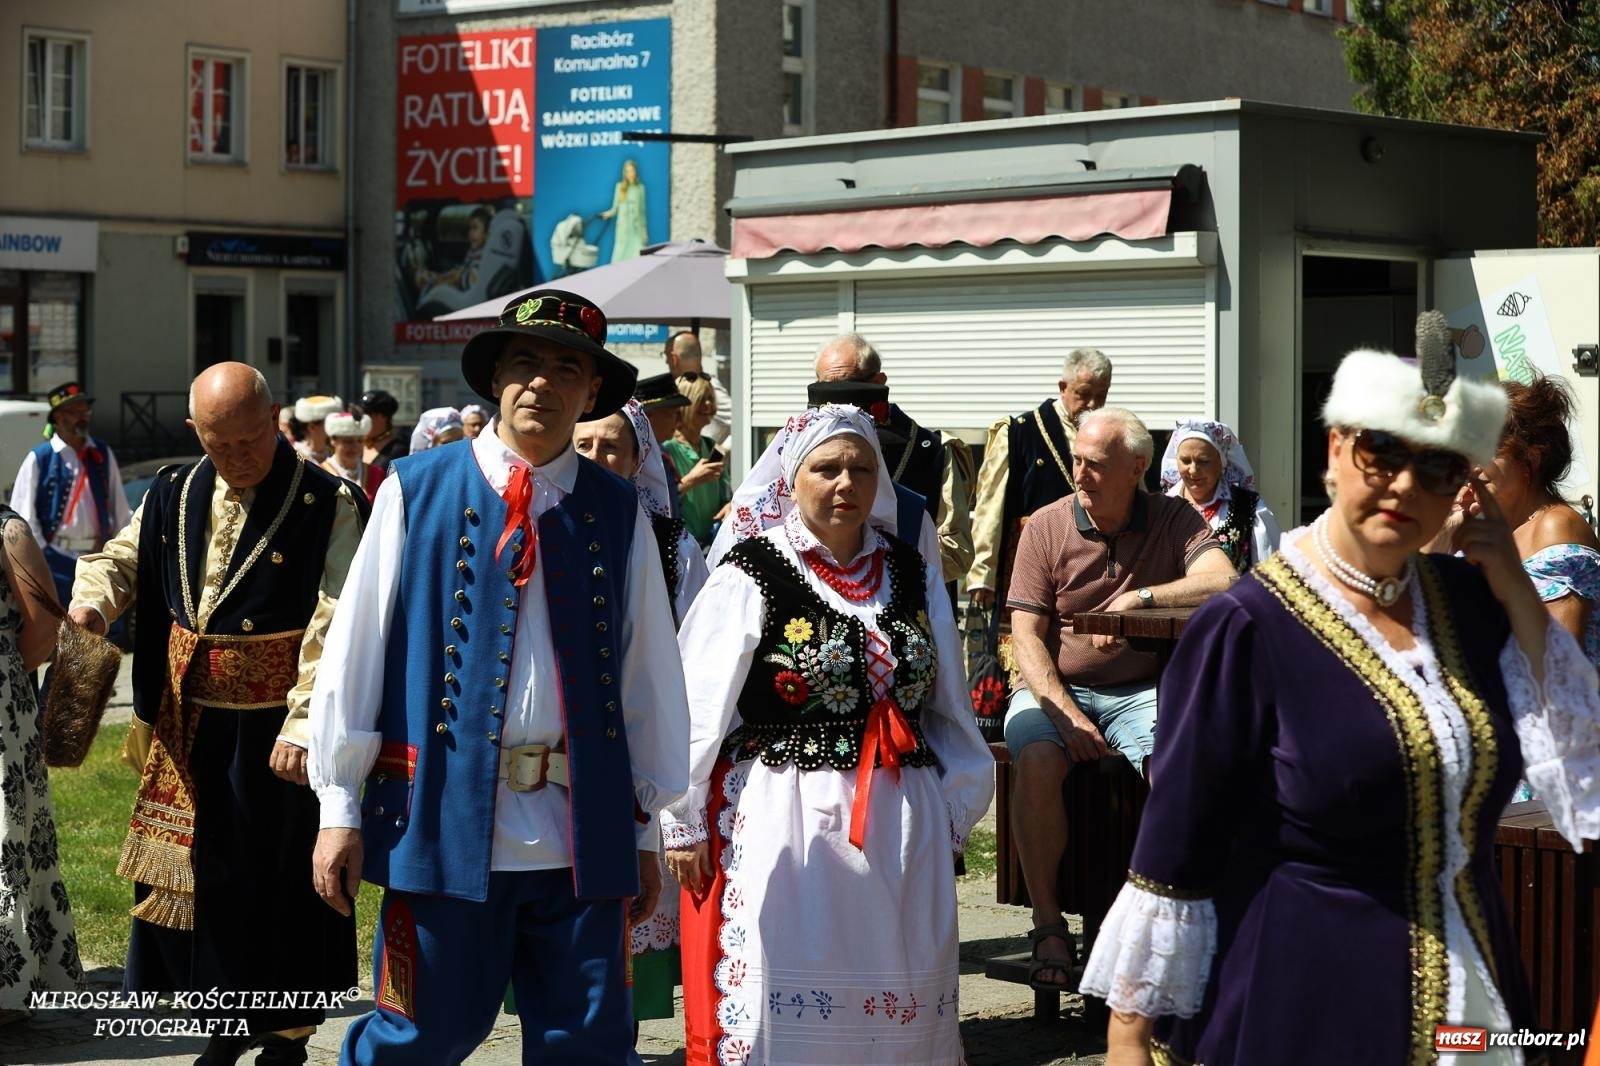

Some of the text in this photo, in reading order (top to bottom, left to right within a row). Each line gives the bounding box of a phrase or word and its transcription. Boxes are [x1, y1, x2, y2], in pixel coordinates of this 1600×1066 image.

[571, 30, 635, 51] Racibórz
[402, 36, 533, 75] FOTELIKI
[554, 51, 651, 73] Komunalna 7
[571, 85, 633, 103] FOTELIKI
[404, 88, 531, 132] RATUJĄ
[542, 105, 662, 127] SAMOCHODOWE
[541, 131, 589, 149] WÓZKI
[405, 140, 522, 187] ŻYCIE!
